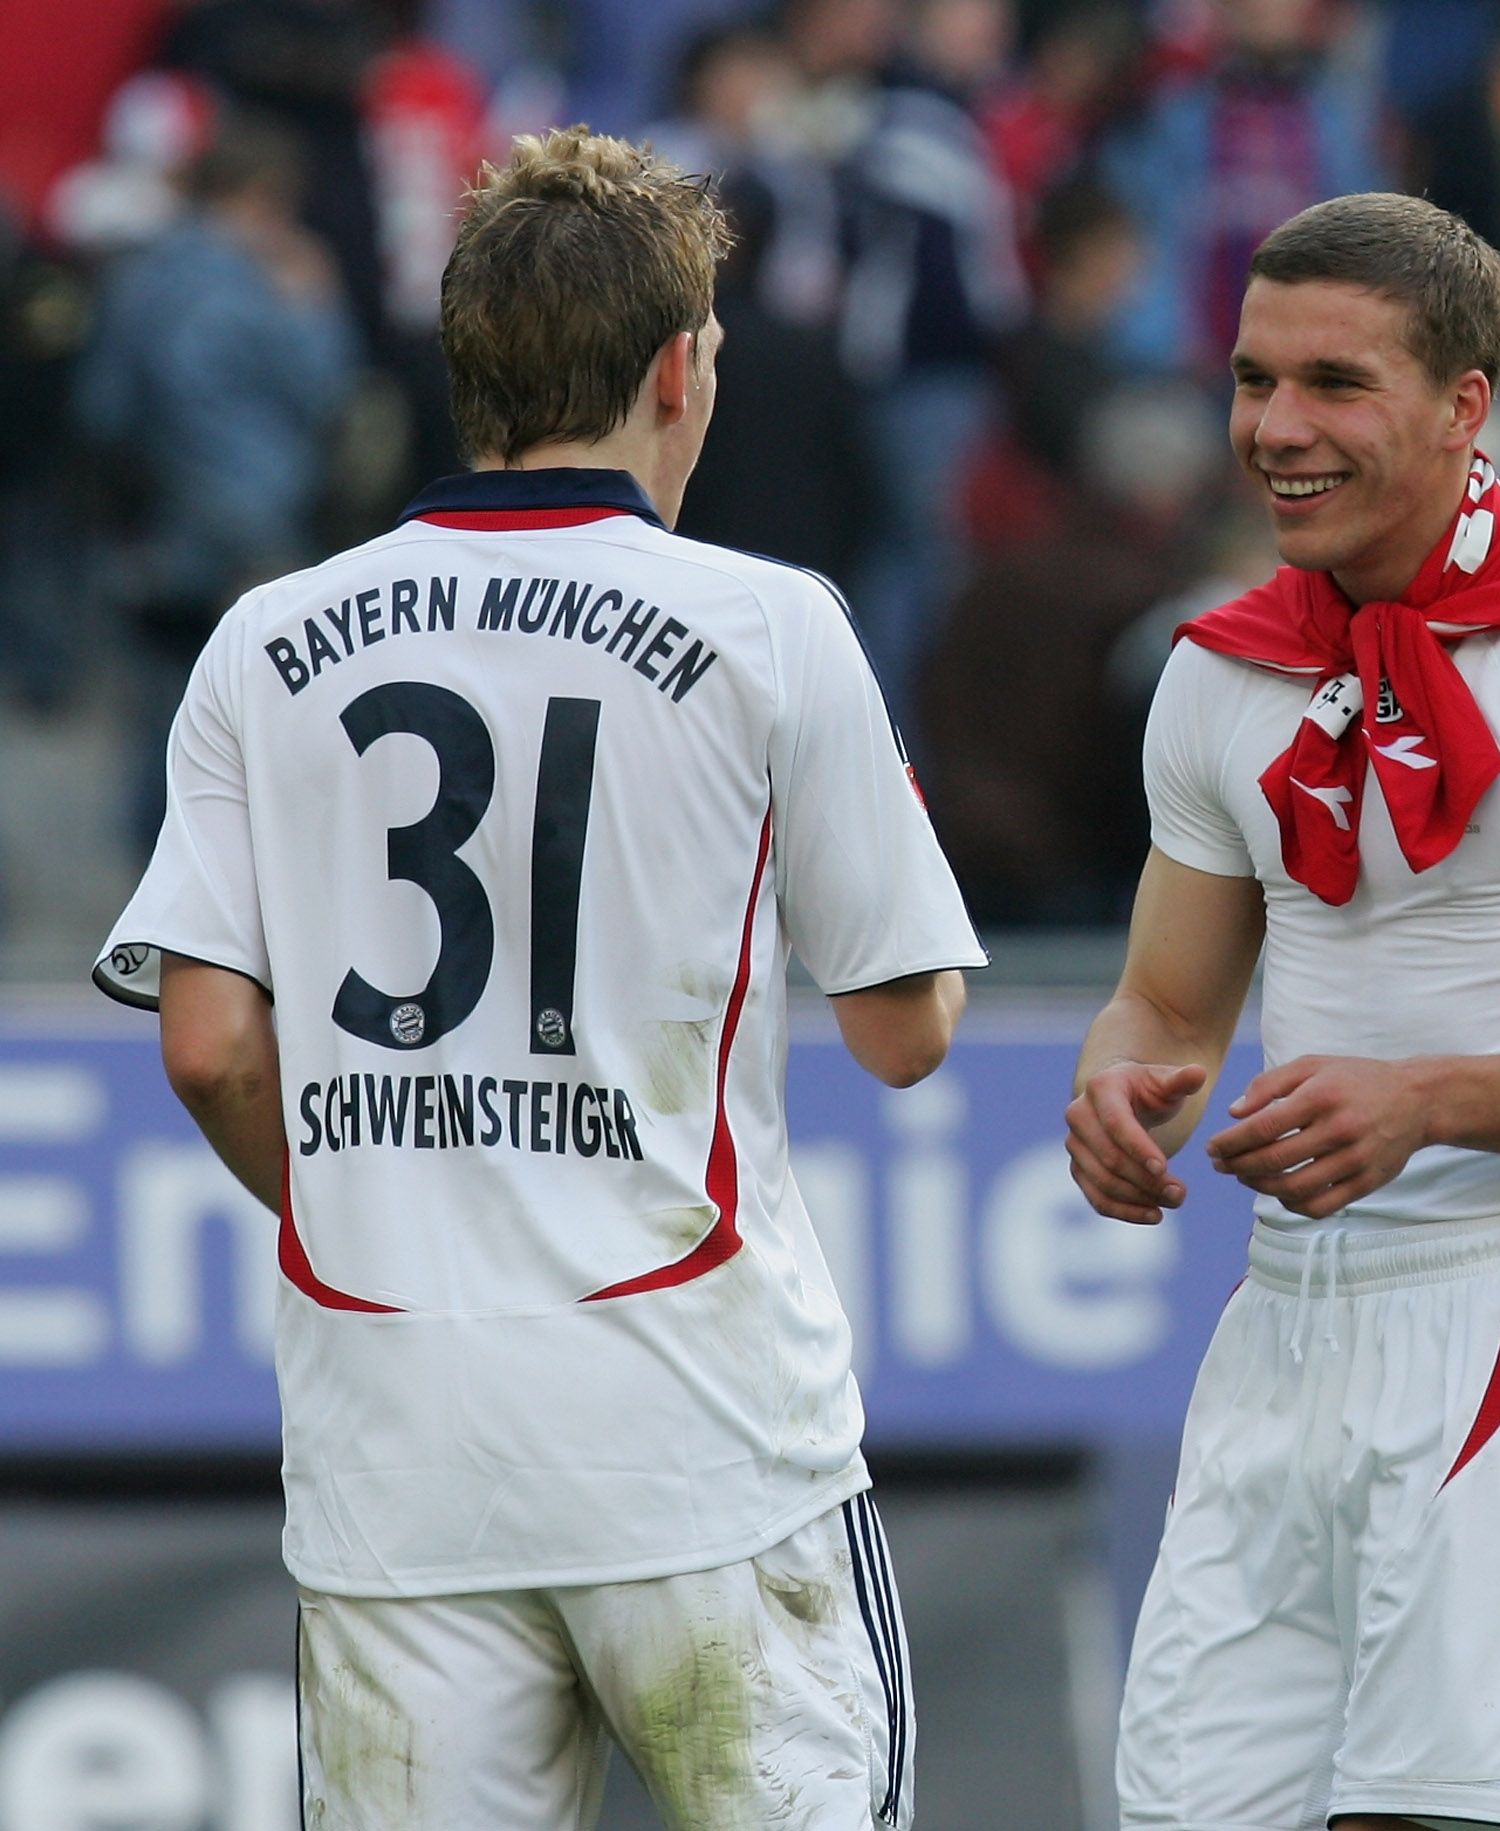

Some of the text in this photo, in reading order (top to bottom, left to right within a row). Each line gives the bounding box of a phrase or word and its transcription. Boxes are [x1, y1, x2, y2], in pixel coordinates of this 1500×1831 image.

[263, 576, 717, 704] BAYERN MÜNCHEN
[331, 681, 602, 1056] 31
[299, 1073, 645, 1162] SCHWEINSTEIGER
